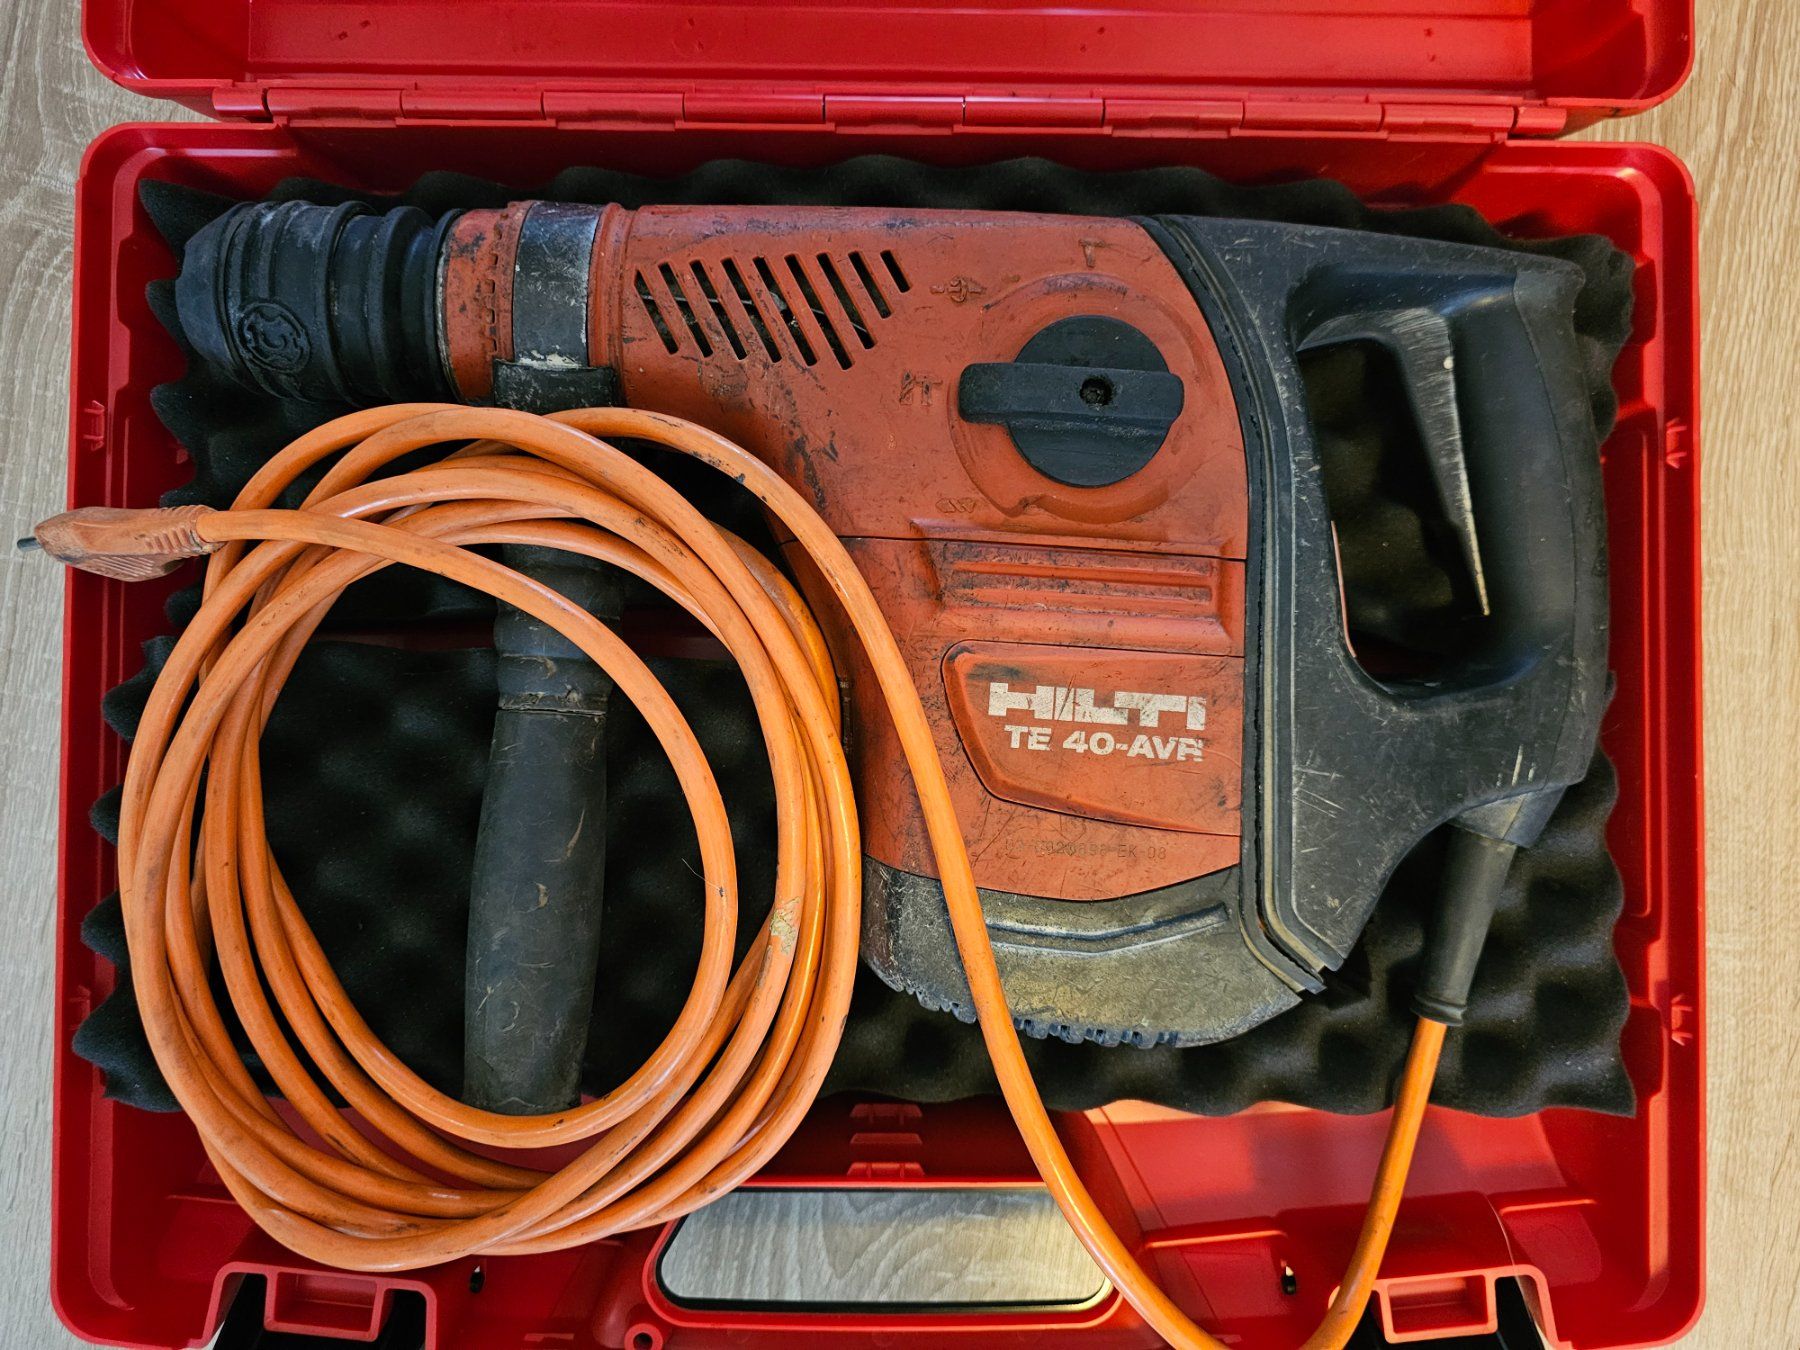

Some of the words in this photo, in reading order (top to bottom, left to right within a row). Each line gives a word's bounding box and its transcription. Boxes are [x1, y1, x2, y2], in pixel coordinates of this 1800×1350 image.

[988, 682, 1207, 731] HILTI
[1004, 724, 1053, 751] TE
[1062, 730, 1204, 762] 40-AVR
